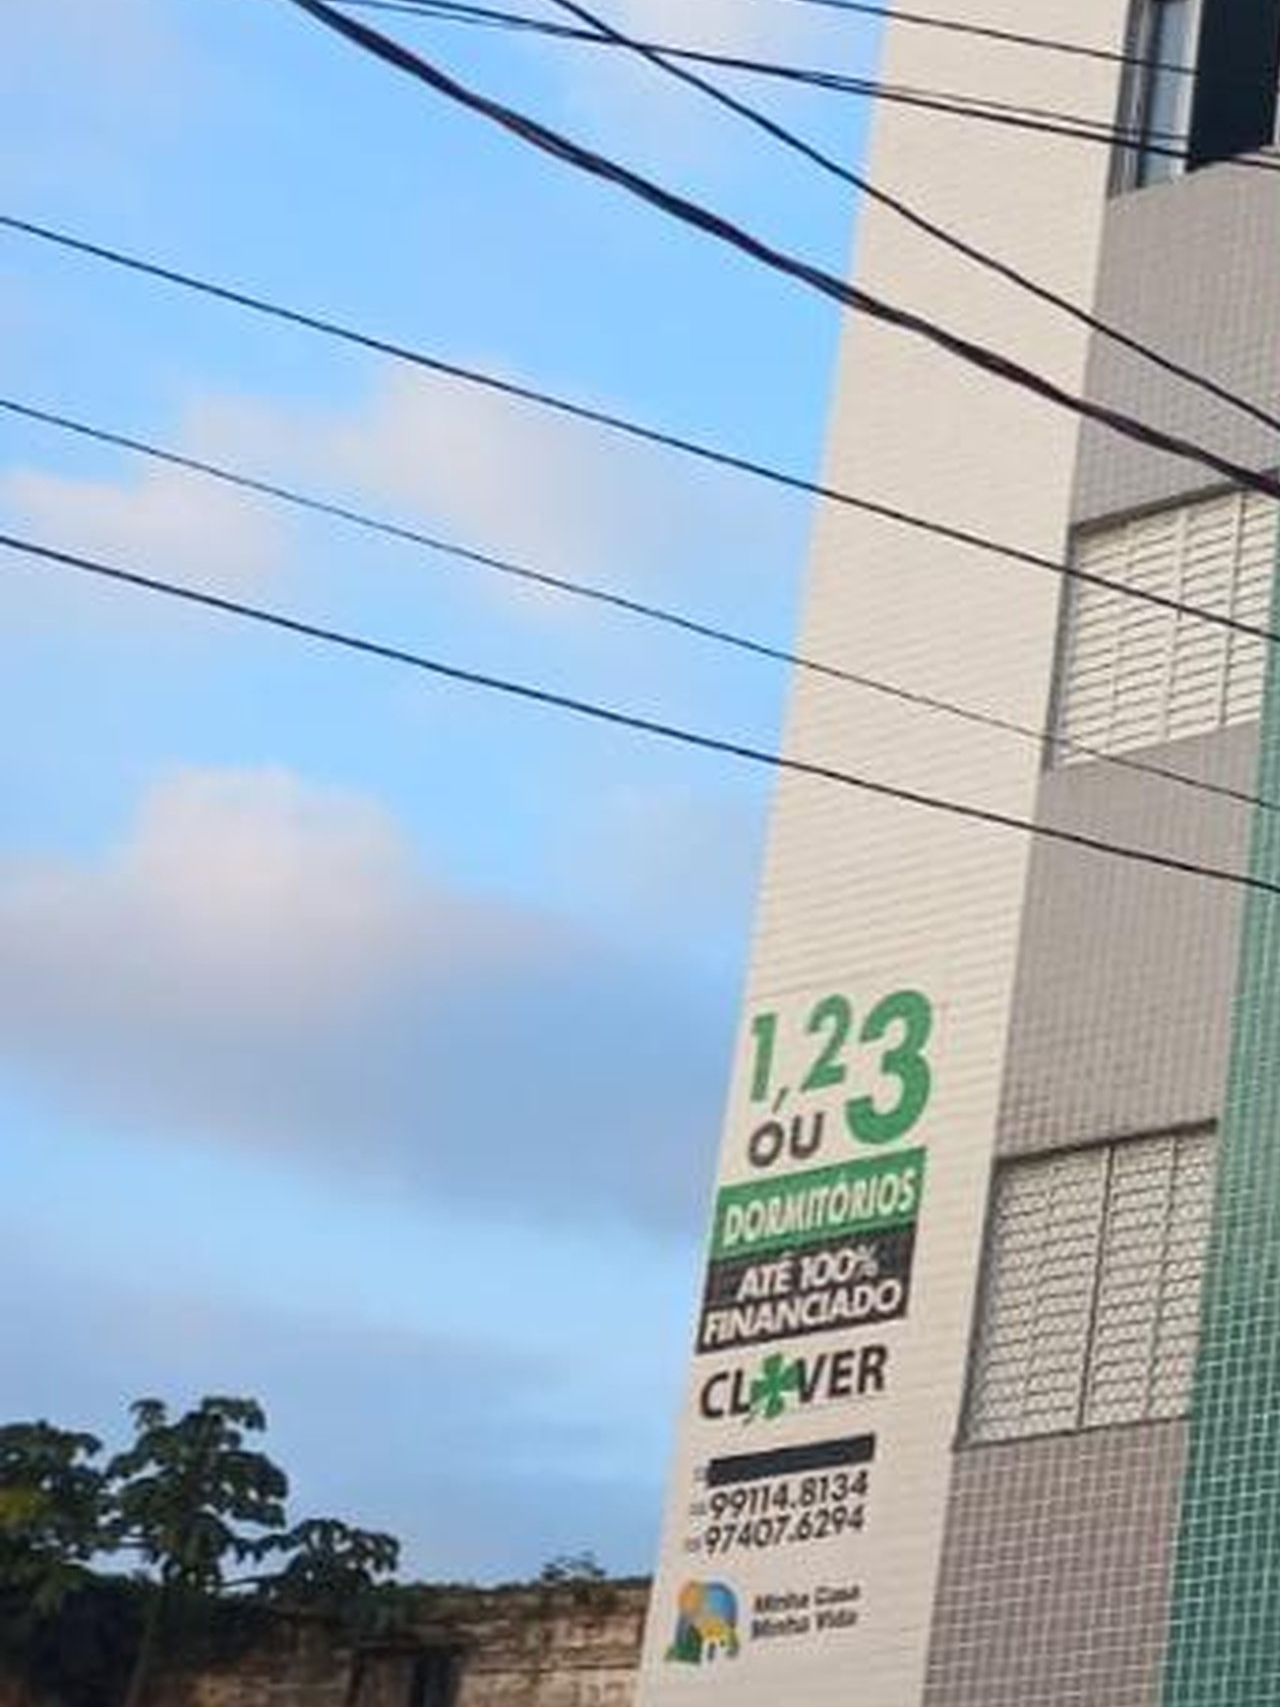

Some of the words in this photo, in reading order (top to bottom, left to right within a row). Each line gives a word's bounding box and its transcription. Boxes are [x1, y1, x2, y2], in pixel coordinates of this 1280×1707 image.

[748, 1112, 825, 1169] OU
[722, 1167, 917, 1248] DORMITÓRIOS
[736, 1249, 793, 1302] ATÉ
[800, 1244, 880, 1290] 100%
[703, 1278, 902, 1344] FINANCIADO
[709, 1469, 869, 1521] 99114.8134
[704, 1504, 865, 1555] 97407.6294
[752, 1615, 811, 1640] Minha
[816, 1609, 859, 1631] Vida
